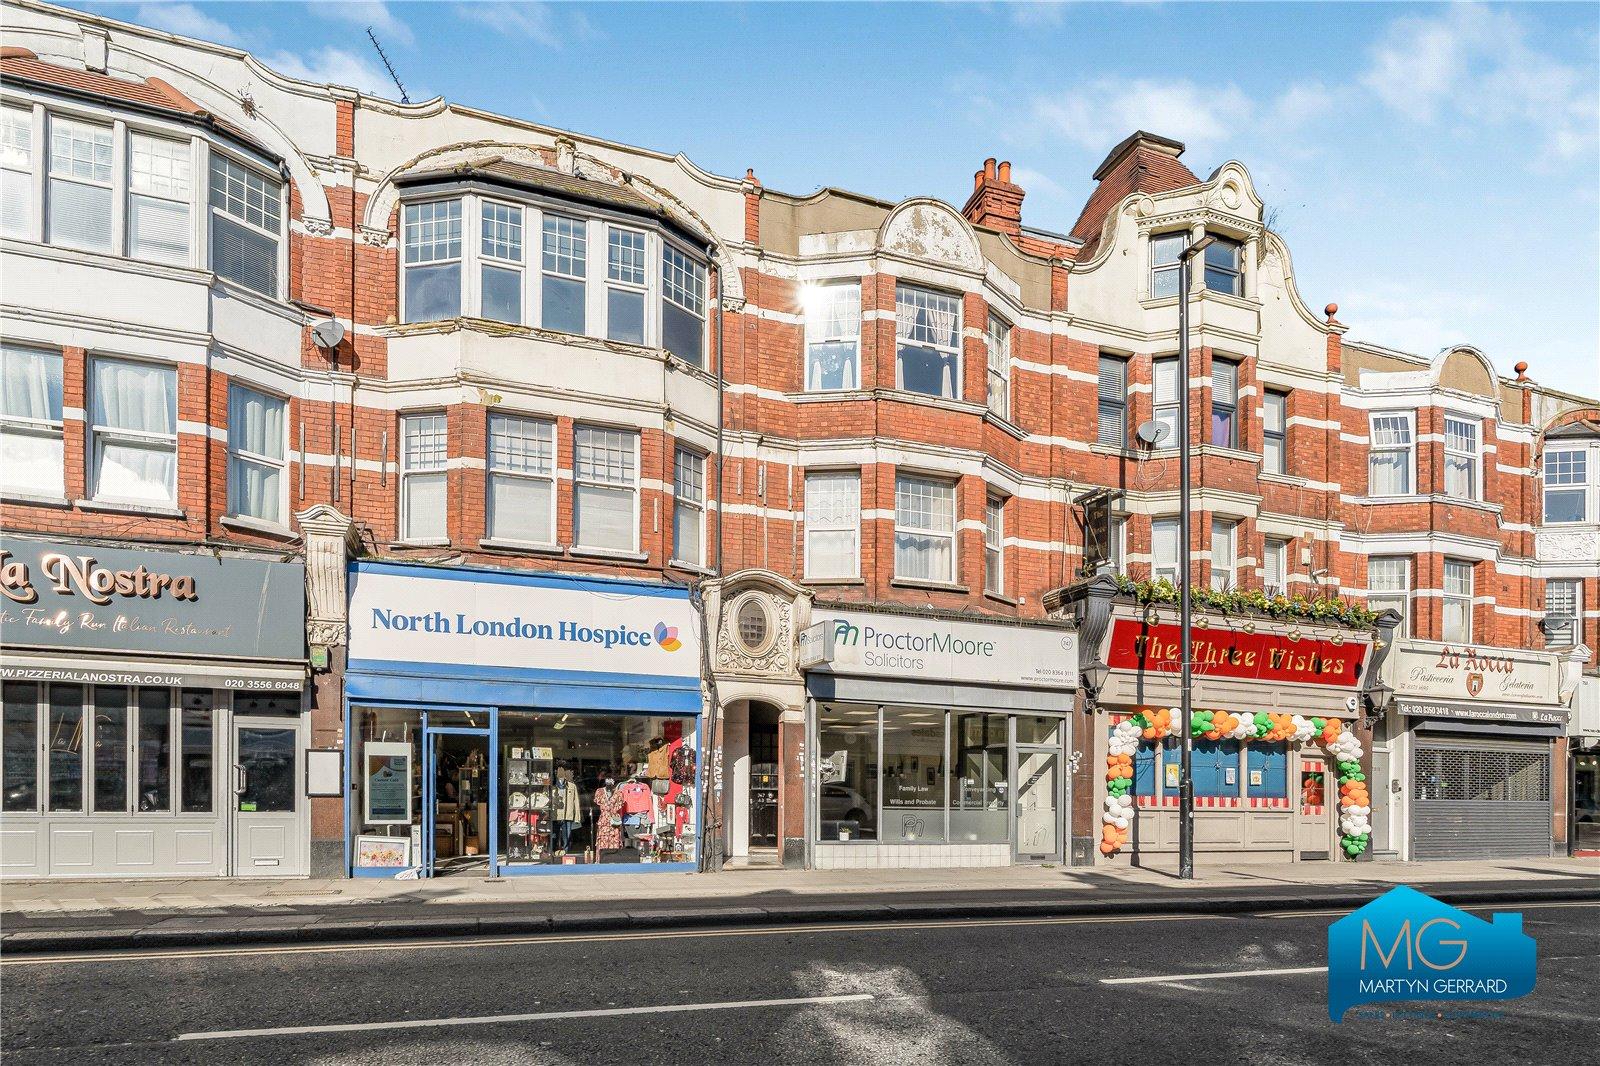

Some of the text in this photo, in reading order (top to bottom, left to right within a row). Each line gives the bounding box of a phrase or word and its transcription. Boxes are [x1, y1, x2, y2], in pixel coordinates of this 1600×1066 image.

[41, 553, 199, 605] Nostra
[21, 608, 74, 635] Family
[78, 612, 106, 630] Run
[112, 614, 157, 633] Italian
[371, 608, 651, 649] North London Hospice
[864, 651, 924, 670] Solicitors
[1135, 635, 1345, 674] The Three Wishes
[1435, 645, 1515, 674] La Rocca
[1410, 666, 1454, 683] Pasticceria
[1499, 672, 1535, 692] Gelateria
[225, 680, 244, 688] 020
[247, 680, 272, 689] 3556
[275, 682, 299, 690] 6048
[1401, 703, 1412, 713] Tel:
[1412, 705, 1423, 714] 020
[1455, 709, 1517, 721] www.laroccalondon.com
[899, 785, 916, 793] Family
